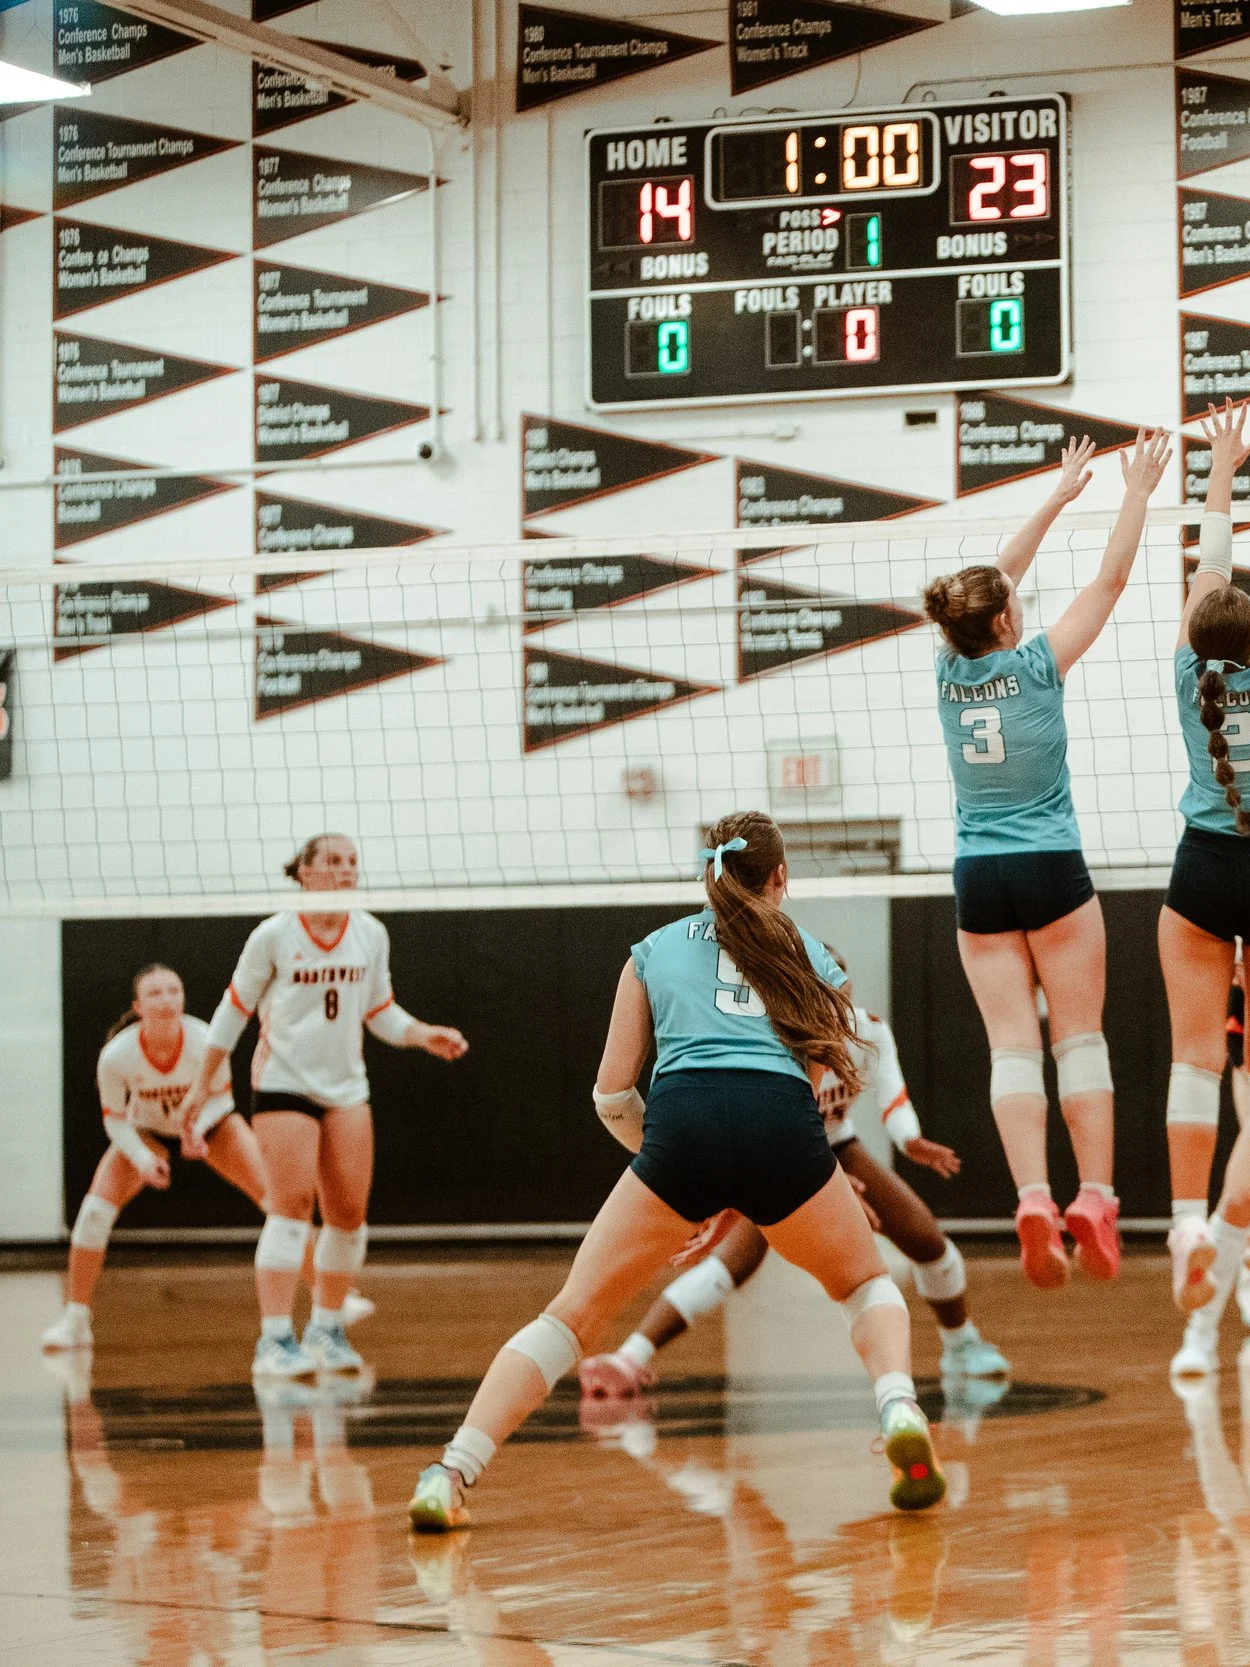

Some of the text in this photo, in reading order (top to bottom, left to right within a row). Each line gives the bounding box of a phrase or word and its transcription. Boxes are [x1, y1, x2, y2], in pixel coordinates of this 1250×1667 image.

[59, 8, 79, 24] 1976
[1180, 8, 1243, 28] Men's Track
[58, 24, 147, 45] Conference Champs
[736, 19, 832, 41] Conference Champs
[58, 43, 131, 65] Men's Basketball
[523, 39, 668, 64] Conference Tournament Champs
[737, 43, 808, 62] Women's Track
[257, 89, 329, 109] Men's Basketball
[1181, 86, 1208, 104] 1987
[943, 108, 1058, 146] VISITOR
[1181, 108, 1246, 127] Conference
[59, 124, 79, 142] 1976
[58, 138, 194, 161] Conference Tournament Champs
[606, 135, 688, 172] HOME
[84, 161, 128, 181] Basketball
[258, 156, 280, 175] 1977
[257, 173, 352, 197] Conference Champs
[968, 153, 1047, 221] 23
[639, 179, 692, 244] 14
[762, 228, 839, 256] PERIOD
[866, 216, 880, 267] 1
[936, 231, 1008, 259] BONUS
[1183, 223, 1242, 244] Conference
[640, 252, 709, 280] BONUS
[734, 280, 893, 315] FOULS PLAYER
[958, 271, 1025, 299] FOULS
[627, 293, 692, 320] FOULS
[845, 308, 878, 361] 0
[990, 299, 1022, 352] 0
[657, 321, 689, 374] 0
[941, 674, 1021, 703] FALCONS
[959, 705, 1007, 765] 3
[325, 988, 339, 1021] 8
